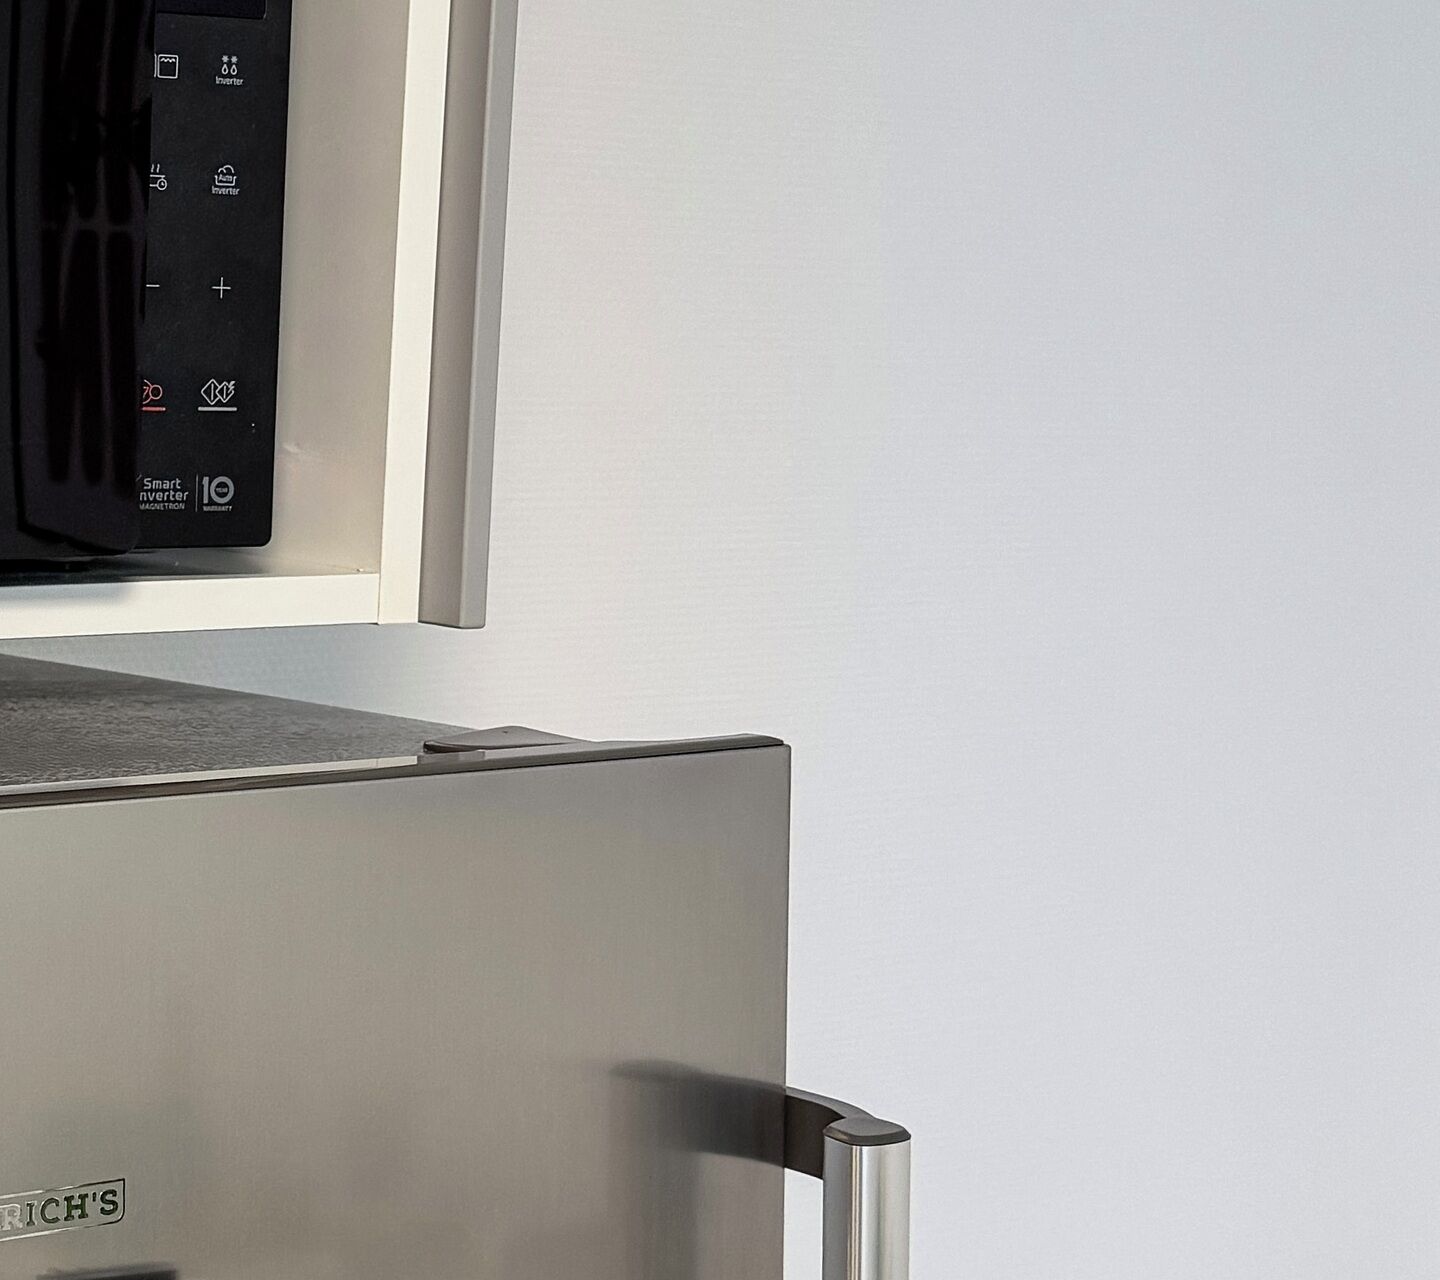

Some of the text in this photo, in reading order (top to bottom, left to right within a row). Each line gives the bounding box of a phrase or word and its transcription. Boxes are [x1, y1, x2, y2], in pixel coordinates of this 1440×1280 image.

[139, 490, 189, 501] nverter
[143, 477, 182, 490] Smart
[202, 475, 235, 504] 10
